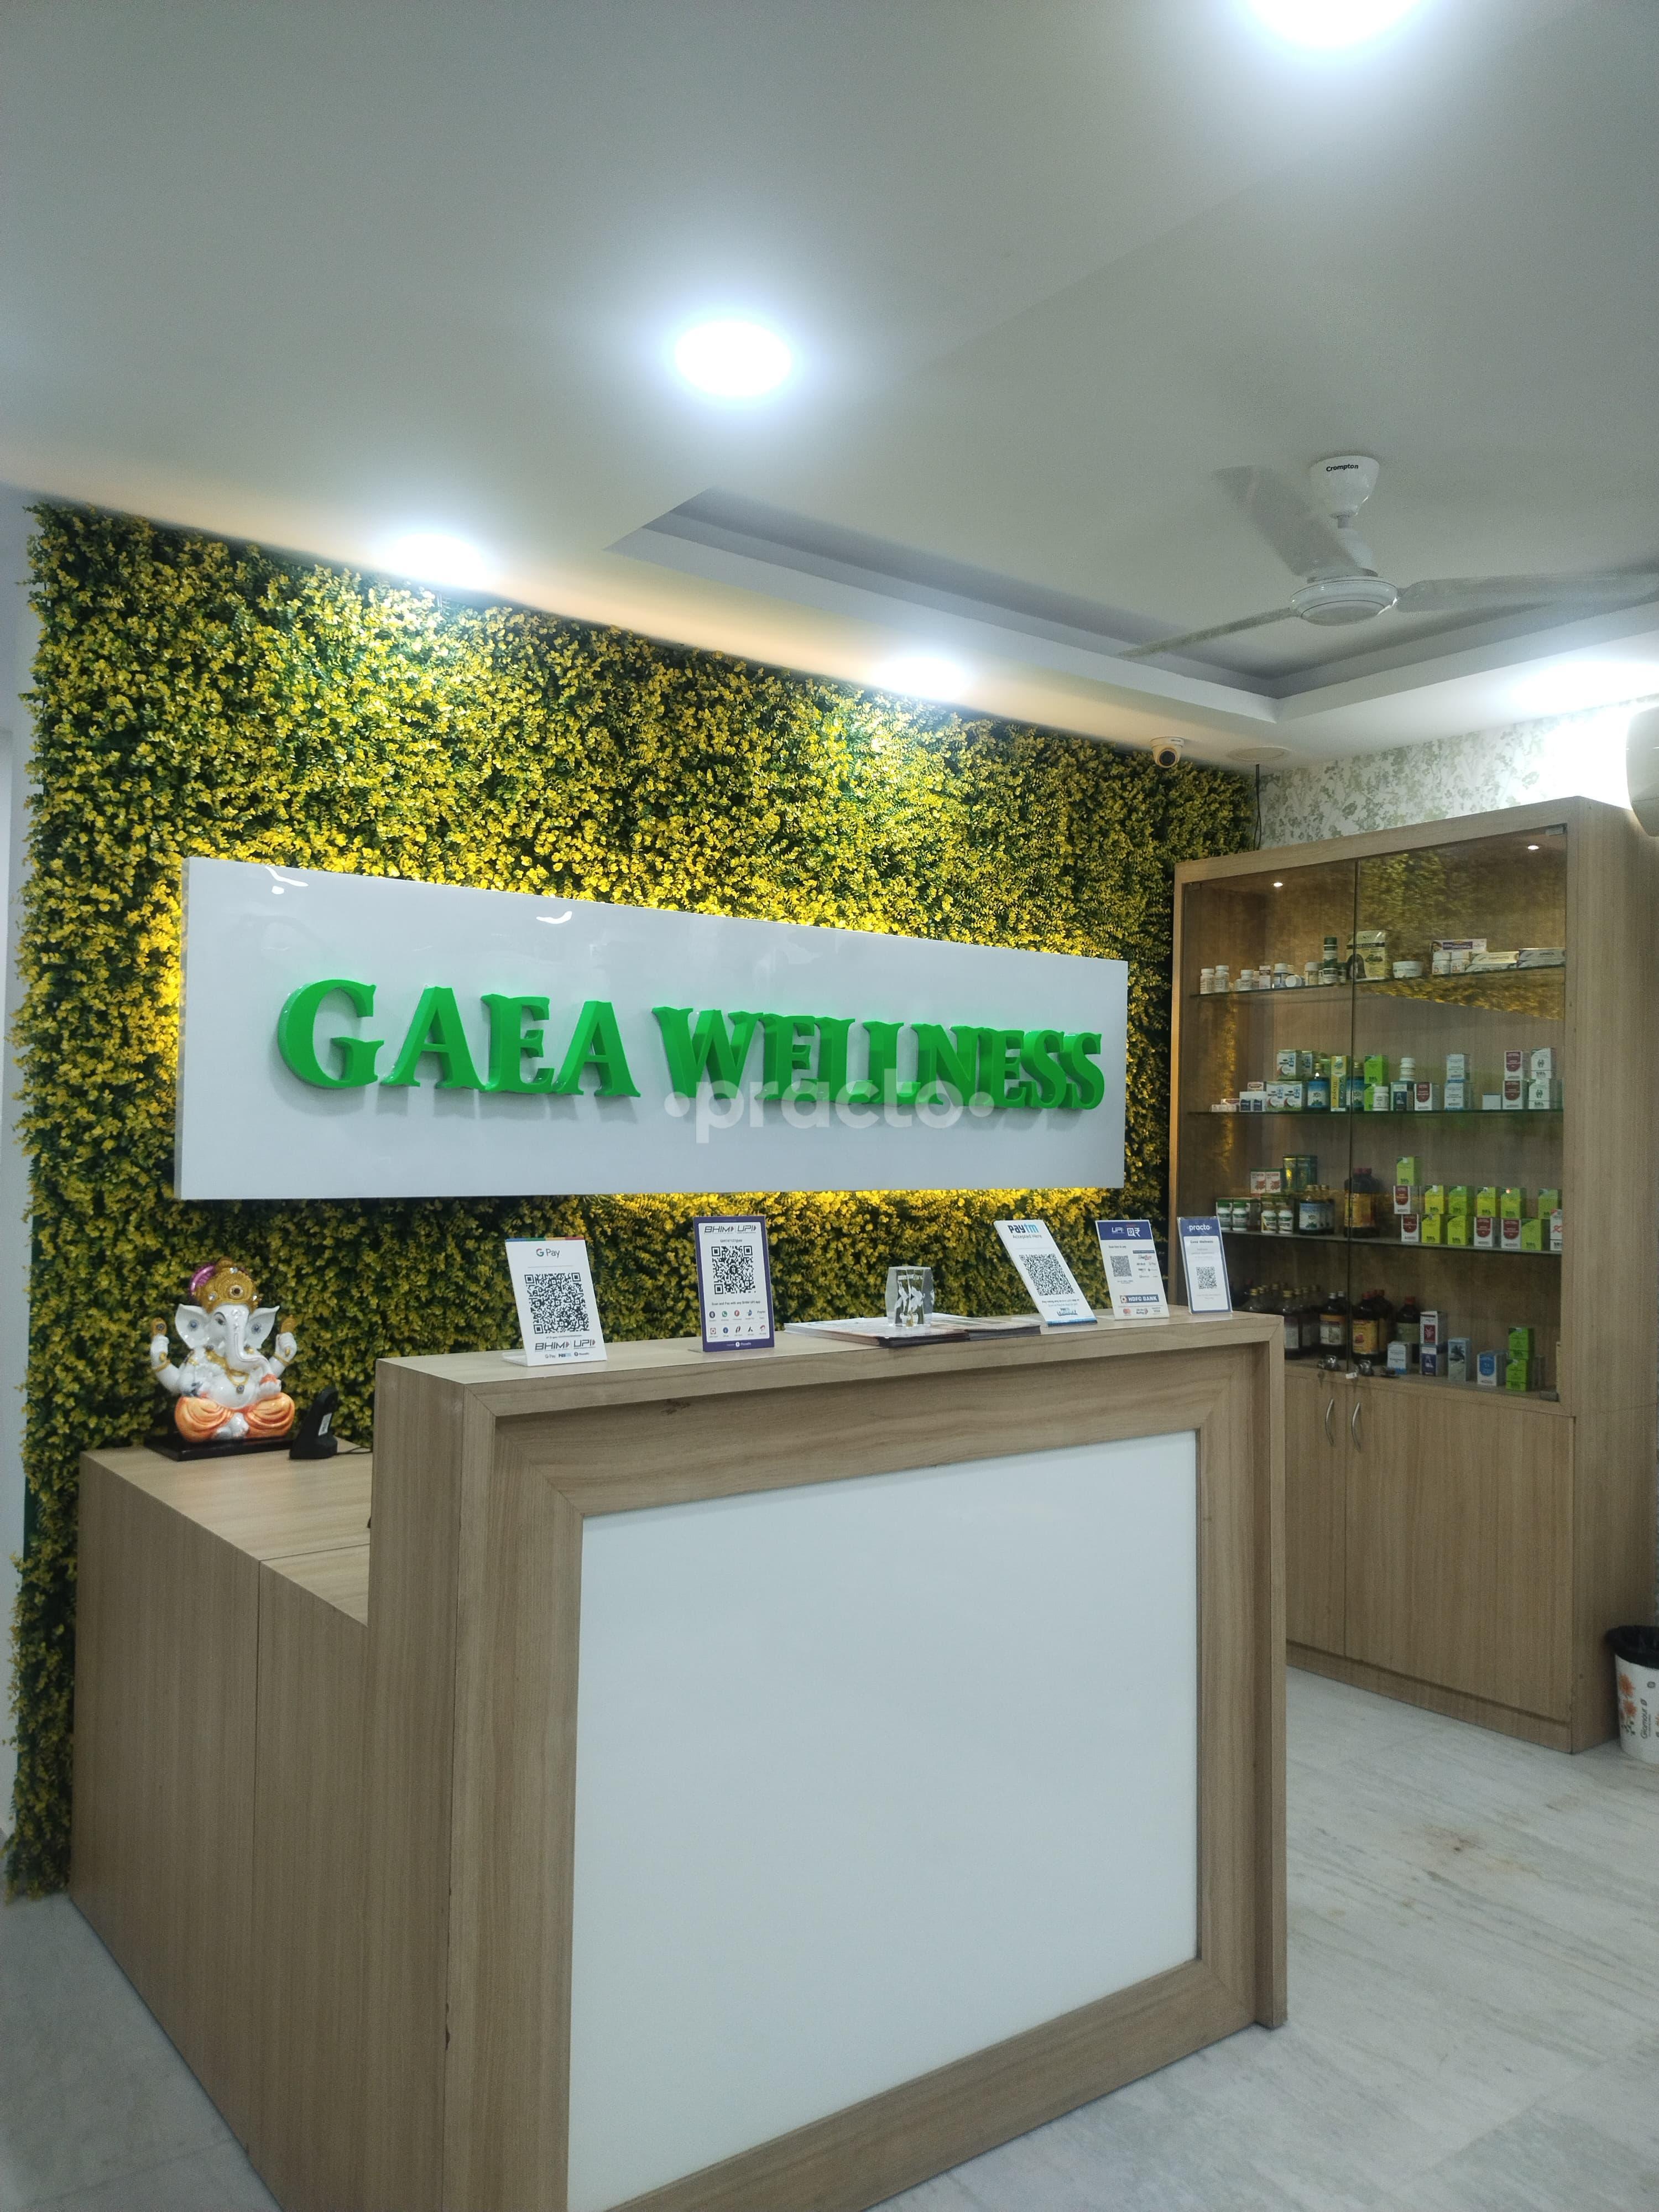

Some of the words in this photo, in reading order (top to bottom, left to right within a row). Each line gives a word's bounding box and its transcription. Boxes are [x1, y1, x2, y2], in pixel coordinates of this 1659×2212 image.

[1326, 463, 1359, 472] Crompton
[277, 979, 641, 1097] GAEA
[651, 1006, 1105, 1110] WELLNESS
[1188, 1224, 1211, 1232] practo
[546, 1248, 560, 1258] Pay
[535, 1342, 565, 1350] BHIM
[573, 1339, 592, 1347] UPI
